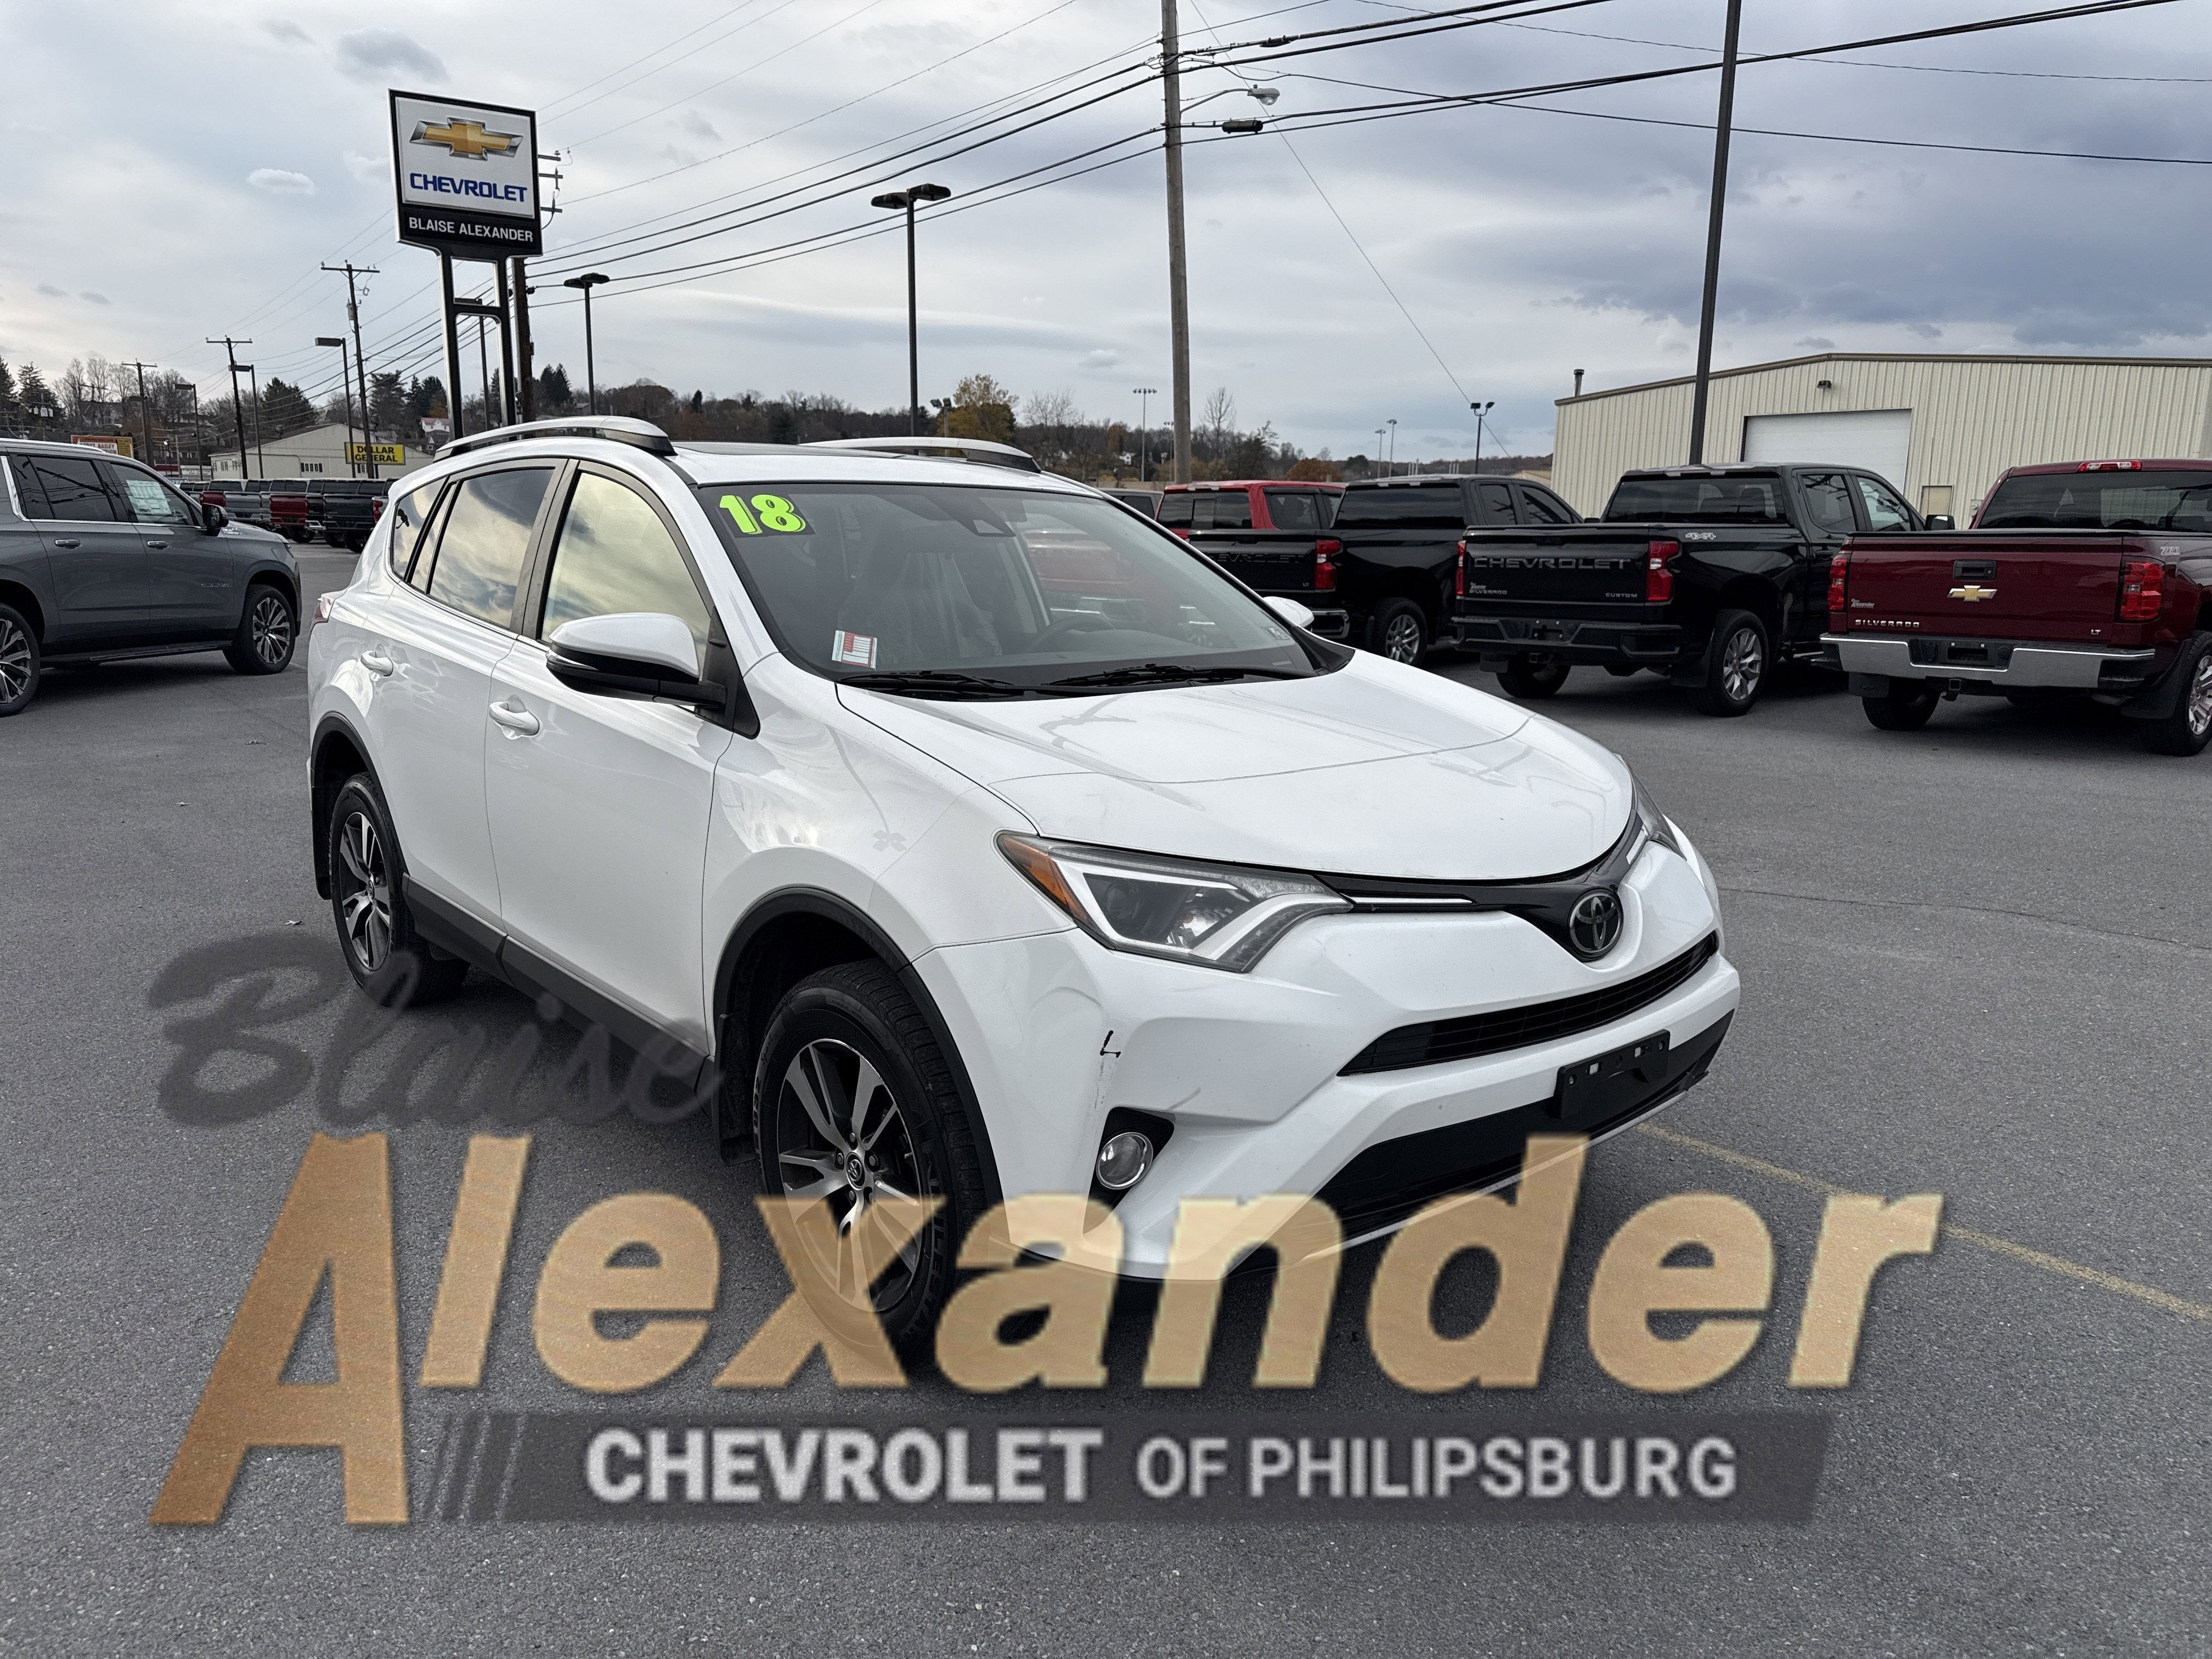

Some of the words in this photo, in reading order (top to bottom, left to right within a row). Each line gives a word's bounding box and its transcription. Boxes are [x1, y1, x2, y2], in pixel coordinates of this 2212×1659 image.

[410, 172, 528, 202] CHEVROLET
[409, 217, 455, 234] BLAISE
[459, 223, 533, 242] ALEXANDER
[356, 445, 395, 454] DLLAR
[354, 454, 398, 462] GEERAL
[719, 494, 806, 535] 18
[1474, 557, 1631, 569] CHEVROLET
[1855, 619, 1920, 628] SILVERADO
